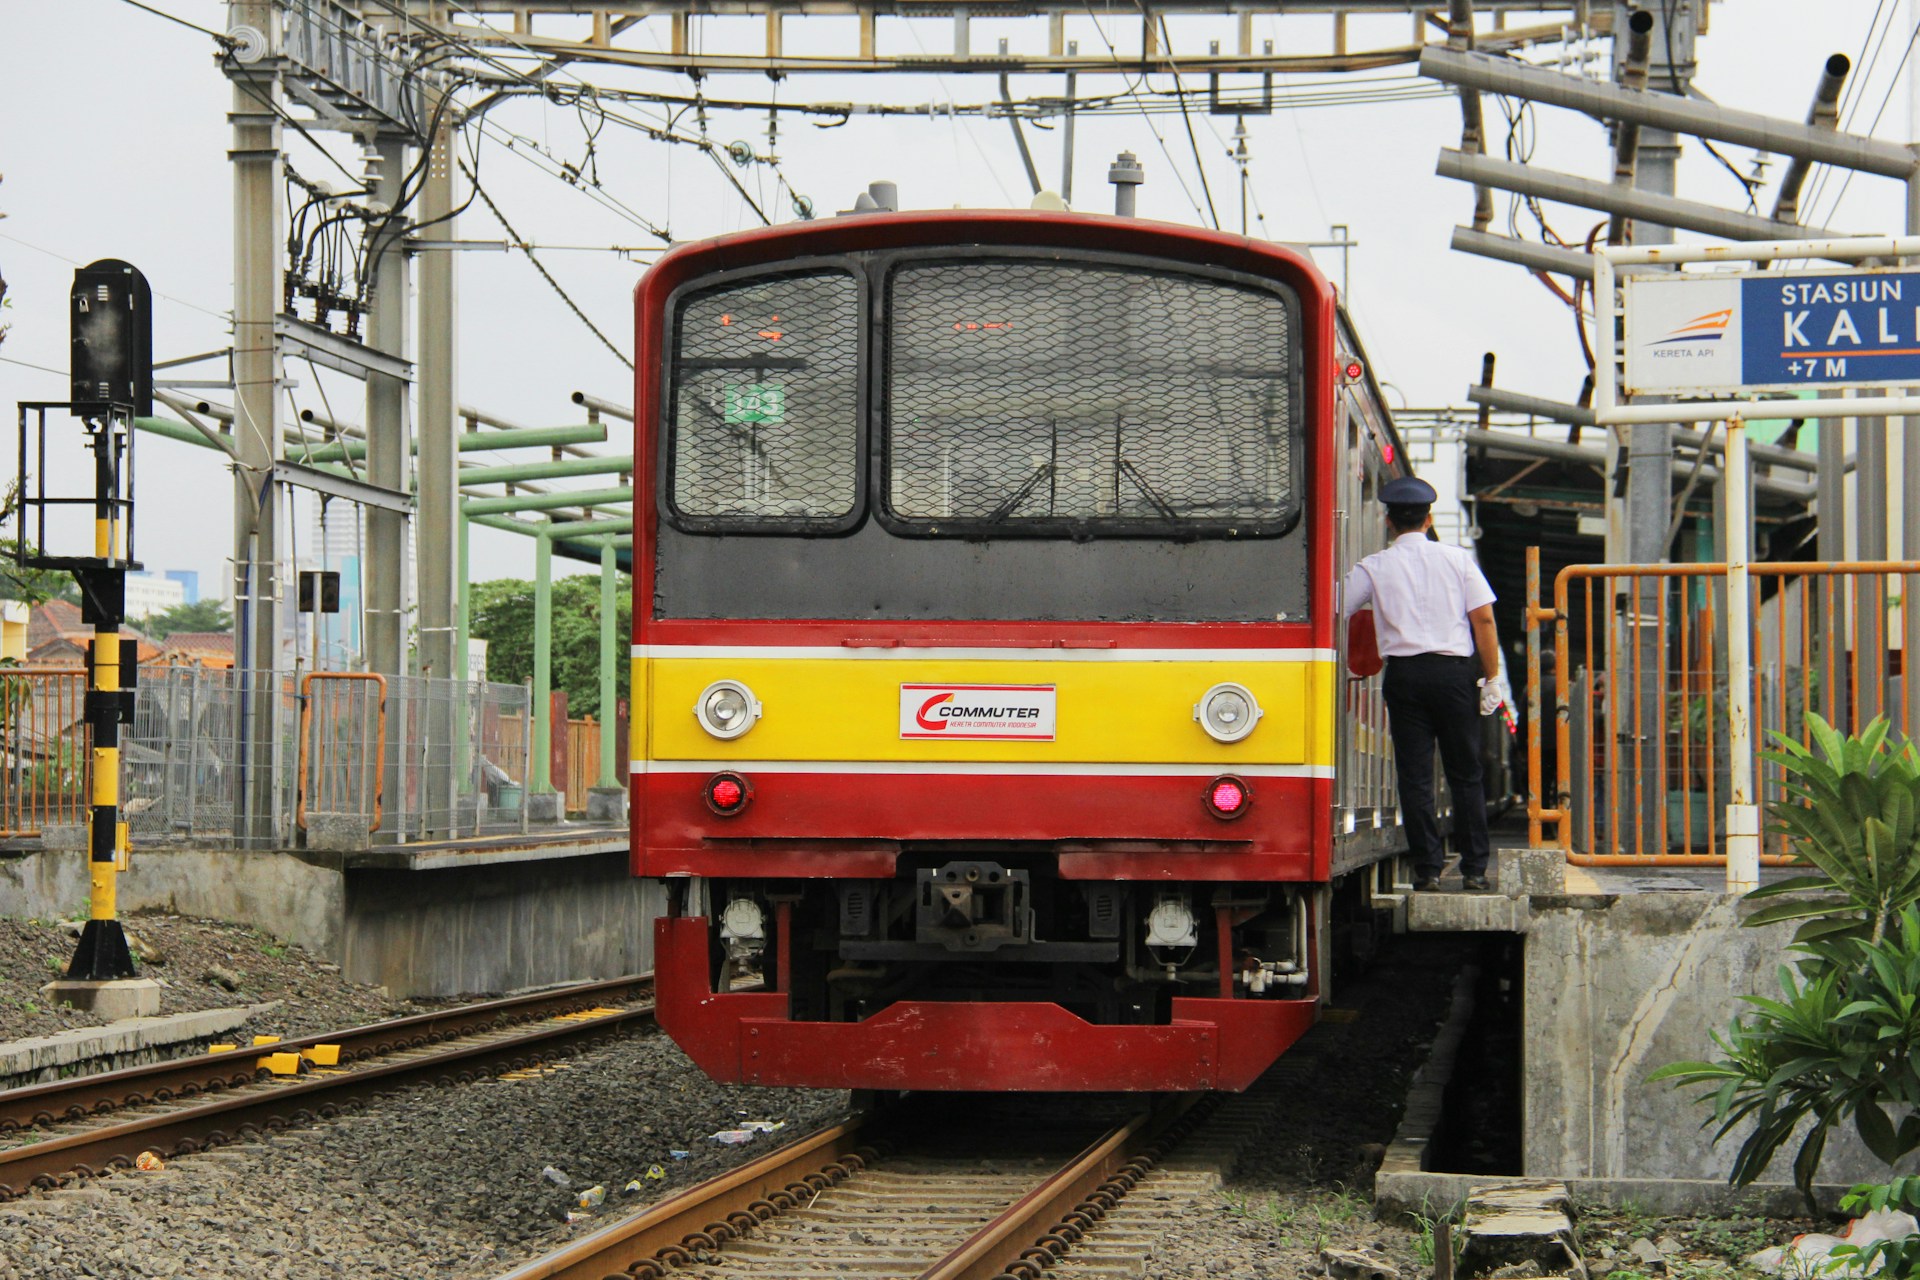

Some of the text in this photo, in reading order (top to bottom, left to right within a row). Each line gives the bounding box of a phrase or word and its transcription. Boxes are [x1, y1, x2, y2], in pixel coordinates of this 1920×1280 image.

[1781, 280, 1902, 305] STASIUN
[1653, 349, 1714, 358] KERETA API
[1787, 358, 1846, 378] +7 M
[939, 706, 1040, 718] COMMUTER
